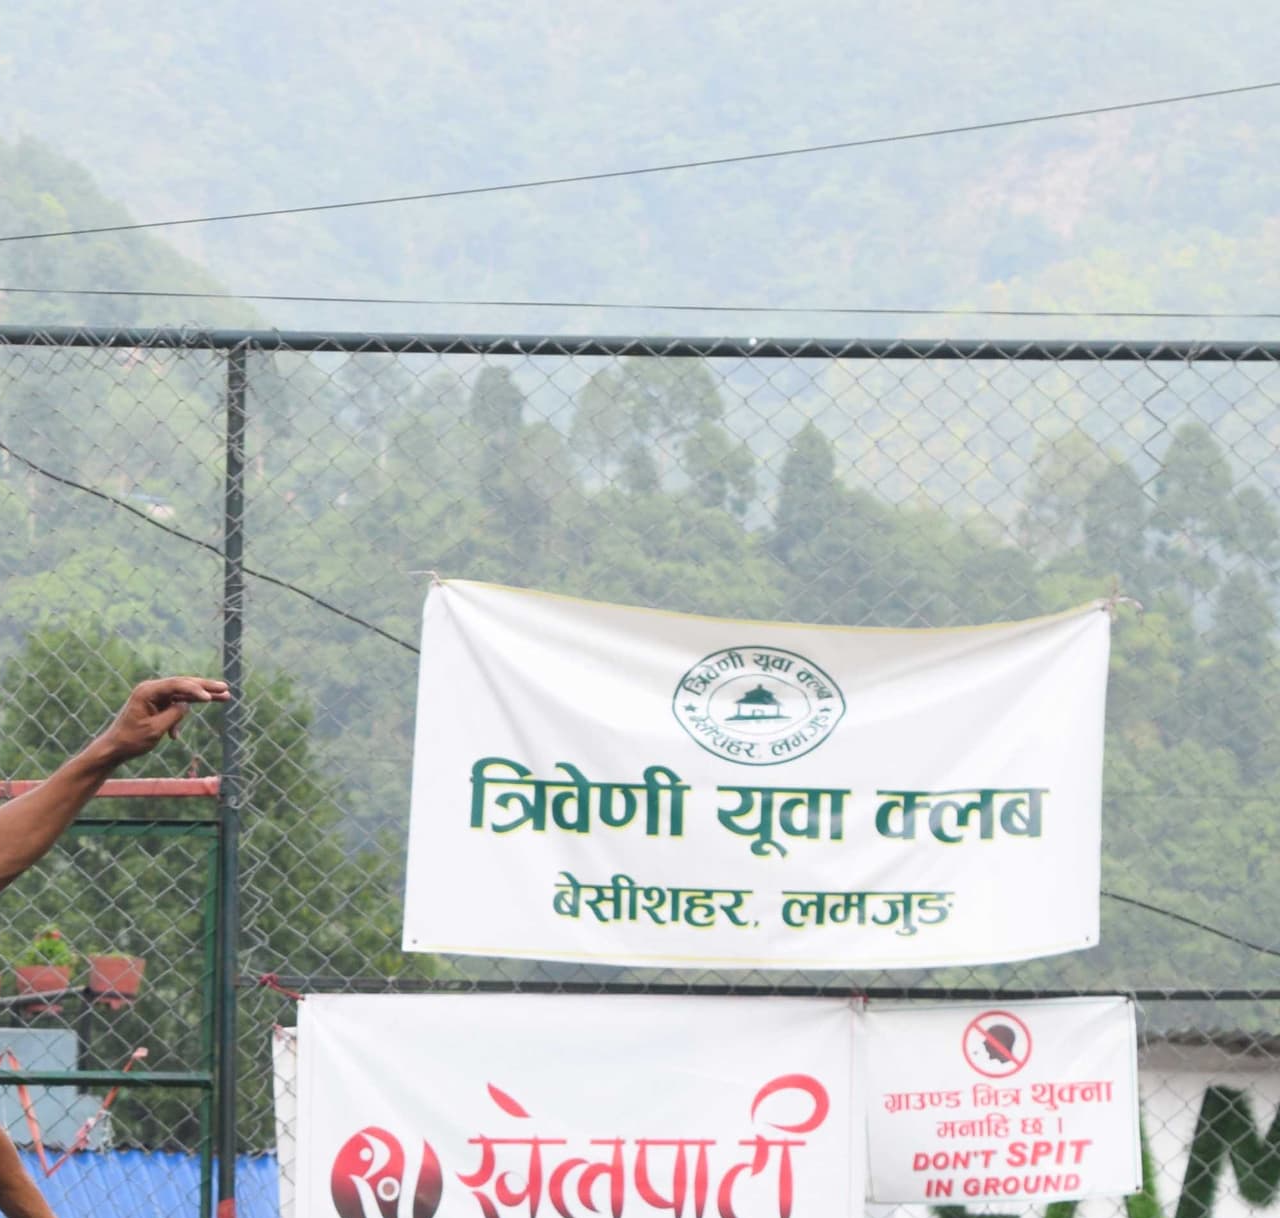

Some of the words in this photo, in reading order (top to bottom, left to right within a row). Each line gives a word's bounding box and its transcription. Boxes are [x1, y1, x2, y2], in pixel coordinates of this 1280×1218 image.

[470, 757, 691, 836] त्रिवेणी
[716, 785, 851, 857] यूवा
[874, 788, 1049, 843] क्लब
[781, 890, 955, 936] लमजुङ
[912, 1149, 996, 1171] DON'T
[1005, 1139, 1093, 1168] SPIT
[924, 1179, 953, 1198] IN
[962, 1173, 1081, 1197] GROUND
